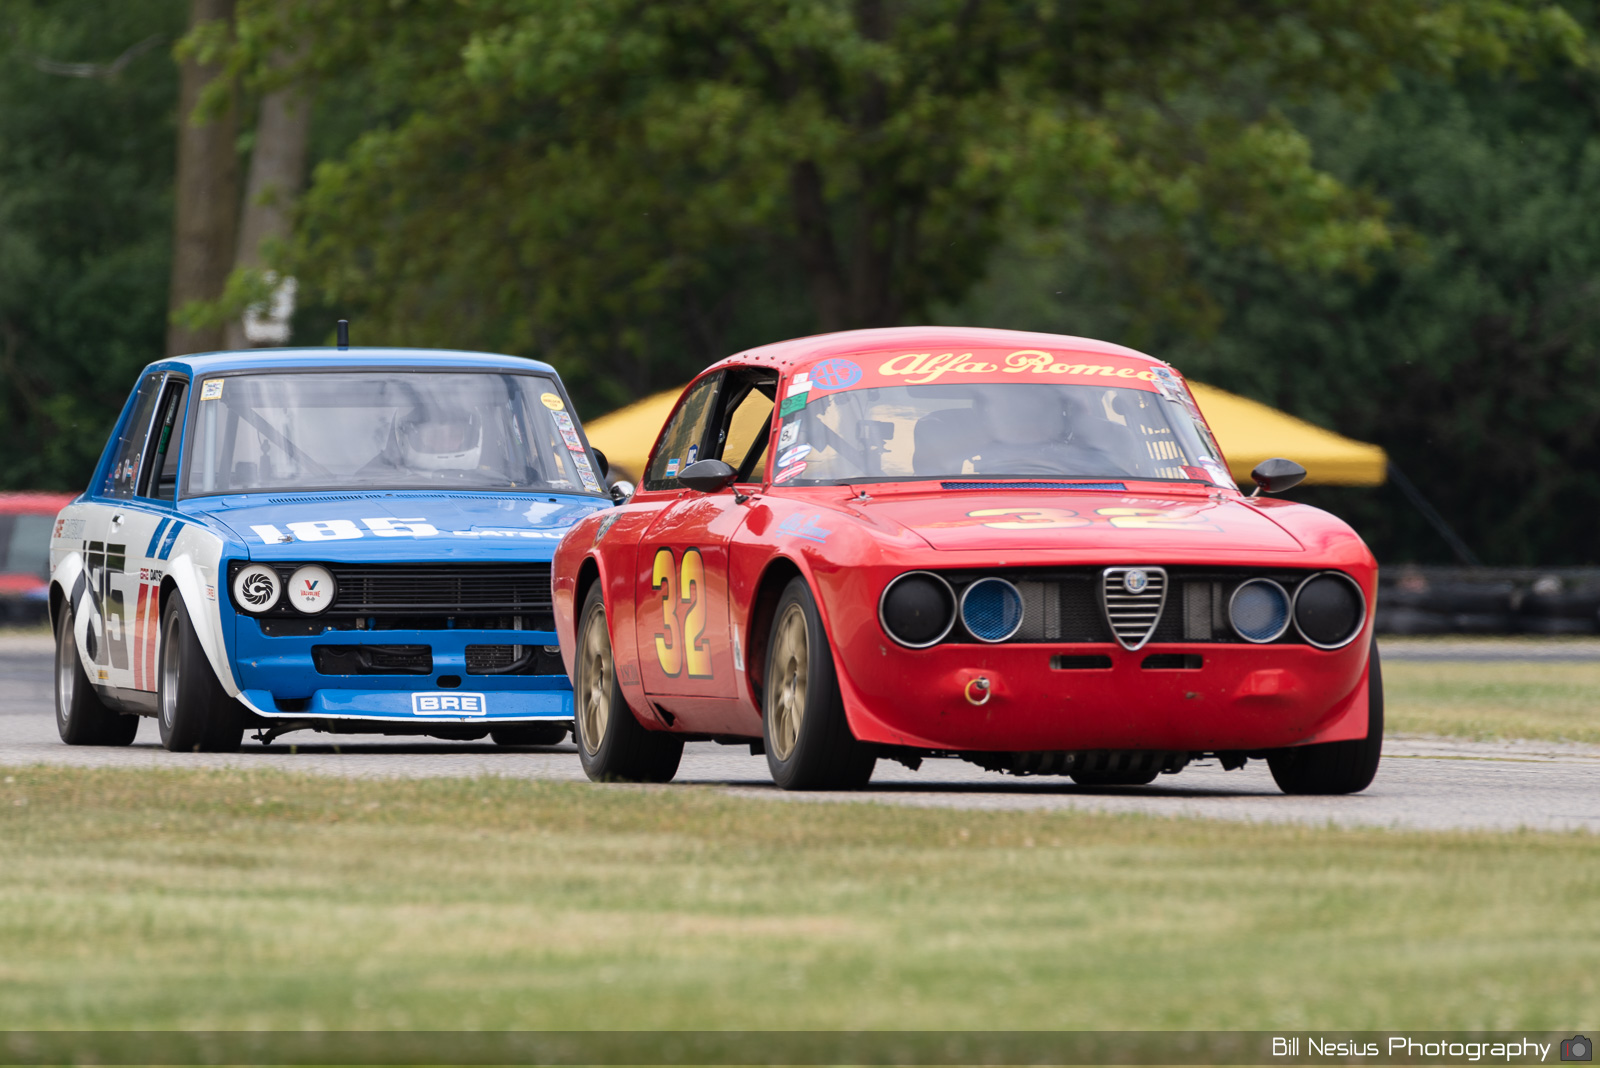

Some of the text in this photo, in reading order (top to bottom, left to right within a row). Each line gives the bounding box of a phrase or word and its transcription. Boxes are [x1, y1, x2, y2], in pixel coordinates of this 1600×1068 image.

[879, 353, 998, 384] Alfa
[1002, 350, 1158, 381] Romeo
[250, 517, 439, 545] 185
[965, 507, 1225, 533] 32
[452, 530, 565, 539] DATSU
[652, 546, 714, 680] 32
[419, 696, 479, 711] BRE
